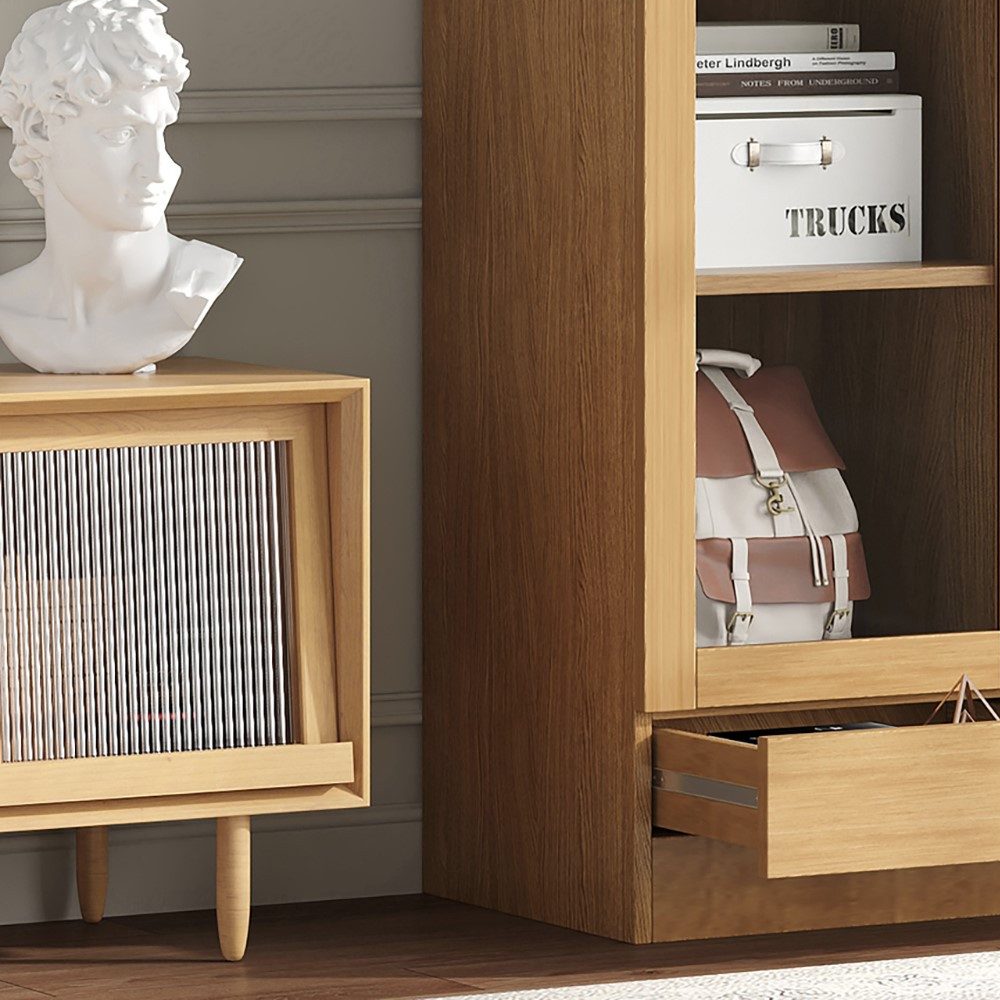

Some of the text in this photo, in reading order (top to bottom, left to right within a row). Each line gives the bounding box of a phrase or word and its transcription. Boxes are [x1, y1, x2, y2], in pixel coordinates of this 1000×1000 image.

[696, 57, 791, 71] eter Lindbergh
[740, 79, 772, 88] NOTES
[777, 78, 804, 87] FROM
[808, 77, 880, 87] UNDERGROUND
[785, 203, 906, 238] TRUCKS
